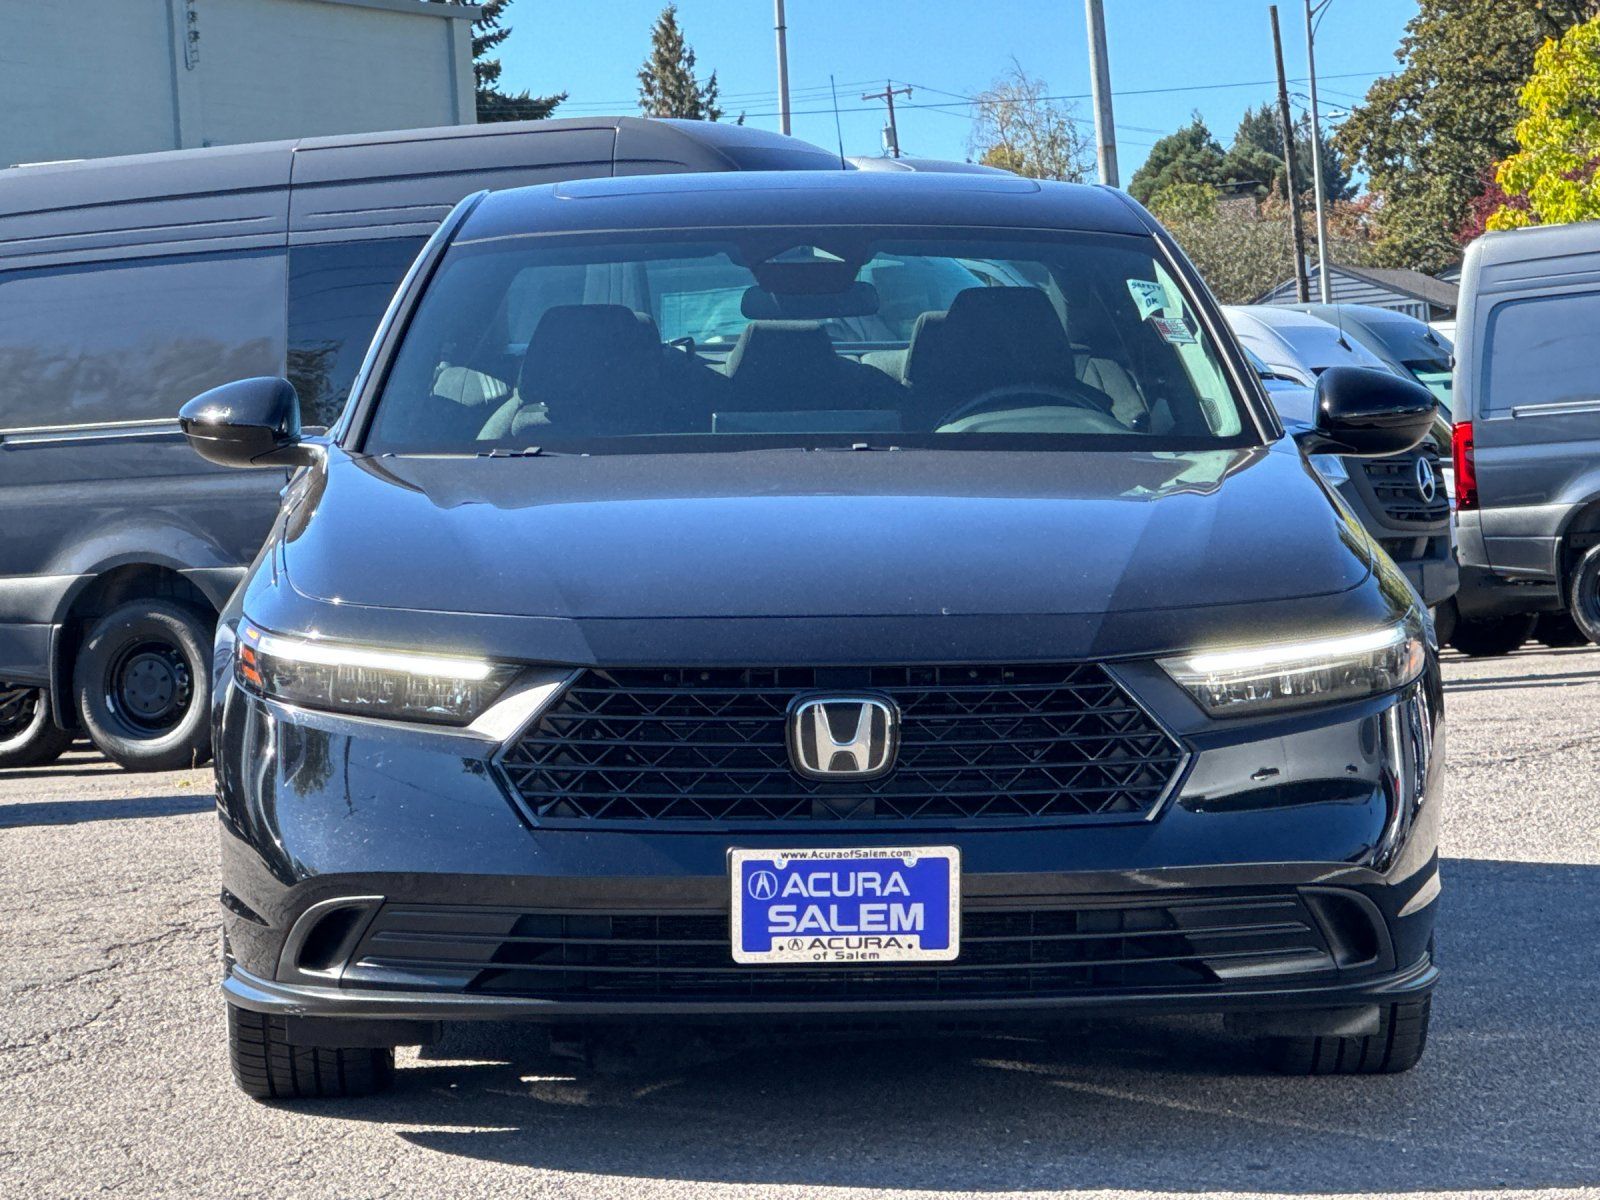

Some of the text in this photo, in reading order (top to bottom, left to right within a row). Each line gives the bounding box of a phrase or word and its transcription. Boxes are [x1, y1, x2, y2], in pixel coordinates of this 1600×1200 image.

[781, 849, 912, 859] www.AcuraofSalem.com
[781, 871, 910, 897] ACURA
[767, 903, 925, 933] SALEM
[807, 937, 903, 950] ACURA
[813, 951, 880, 960] of Salem
